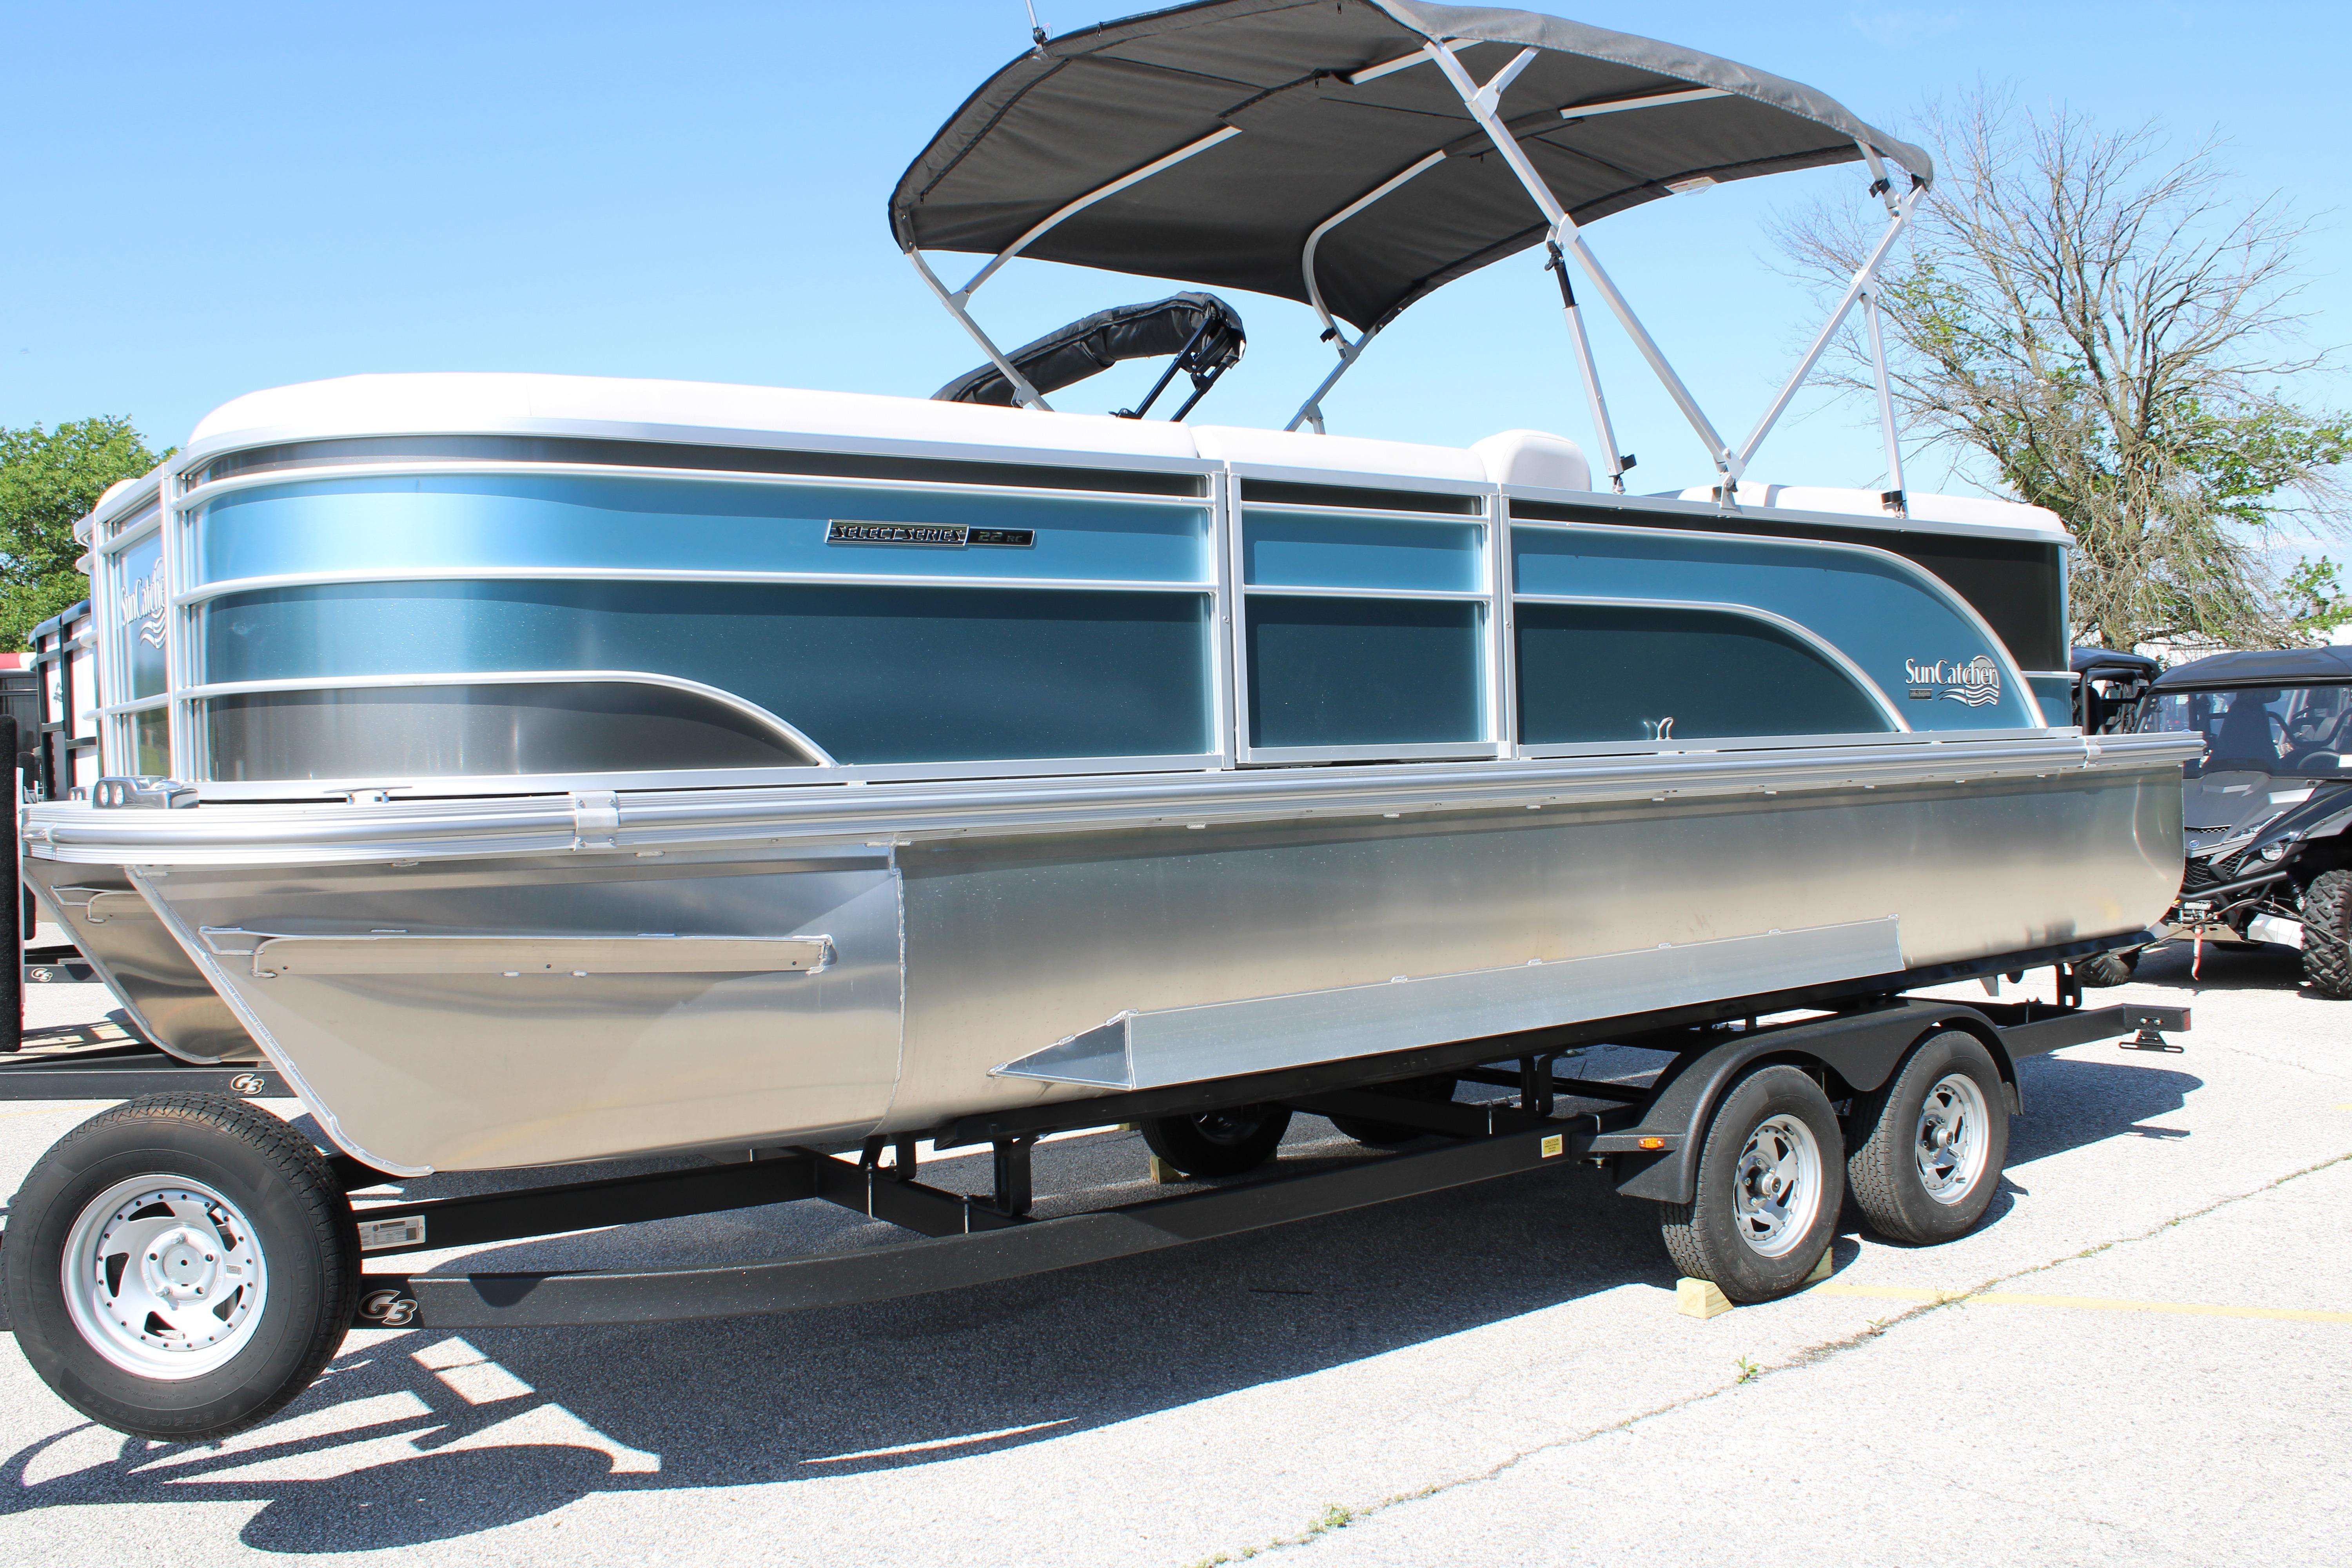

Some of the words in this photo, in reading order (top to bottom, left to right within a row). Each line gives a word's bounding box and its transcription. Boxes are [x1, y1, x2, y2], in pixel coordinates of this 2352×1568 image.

[833, 526, 900, 540] SELECT
[902, 528, 963, 542] SERIES
[978, 532, 1003, 542] 22
[121, 570, 165, 626] SunCatche
[1905, 658, 1996, 685] SunCatcher
[31, 967, 53, 982] G3
[230, 1073, 265, 1094] G3
[358, 1289, 418, 1325] G3
